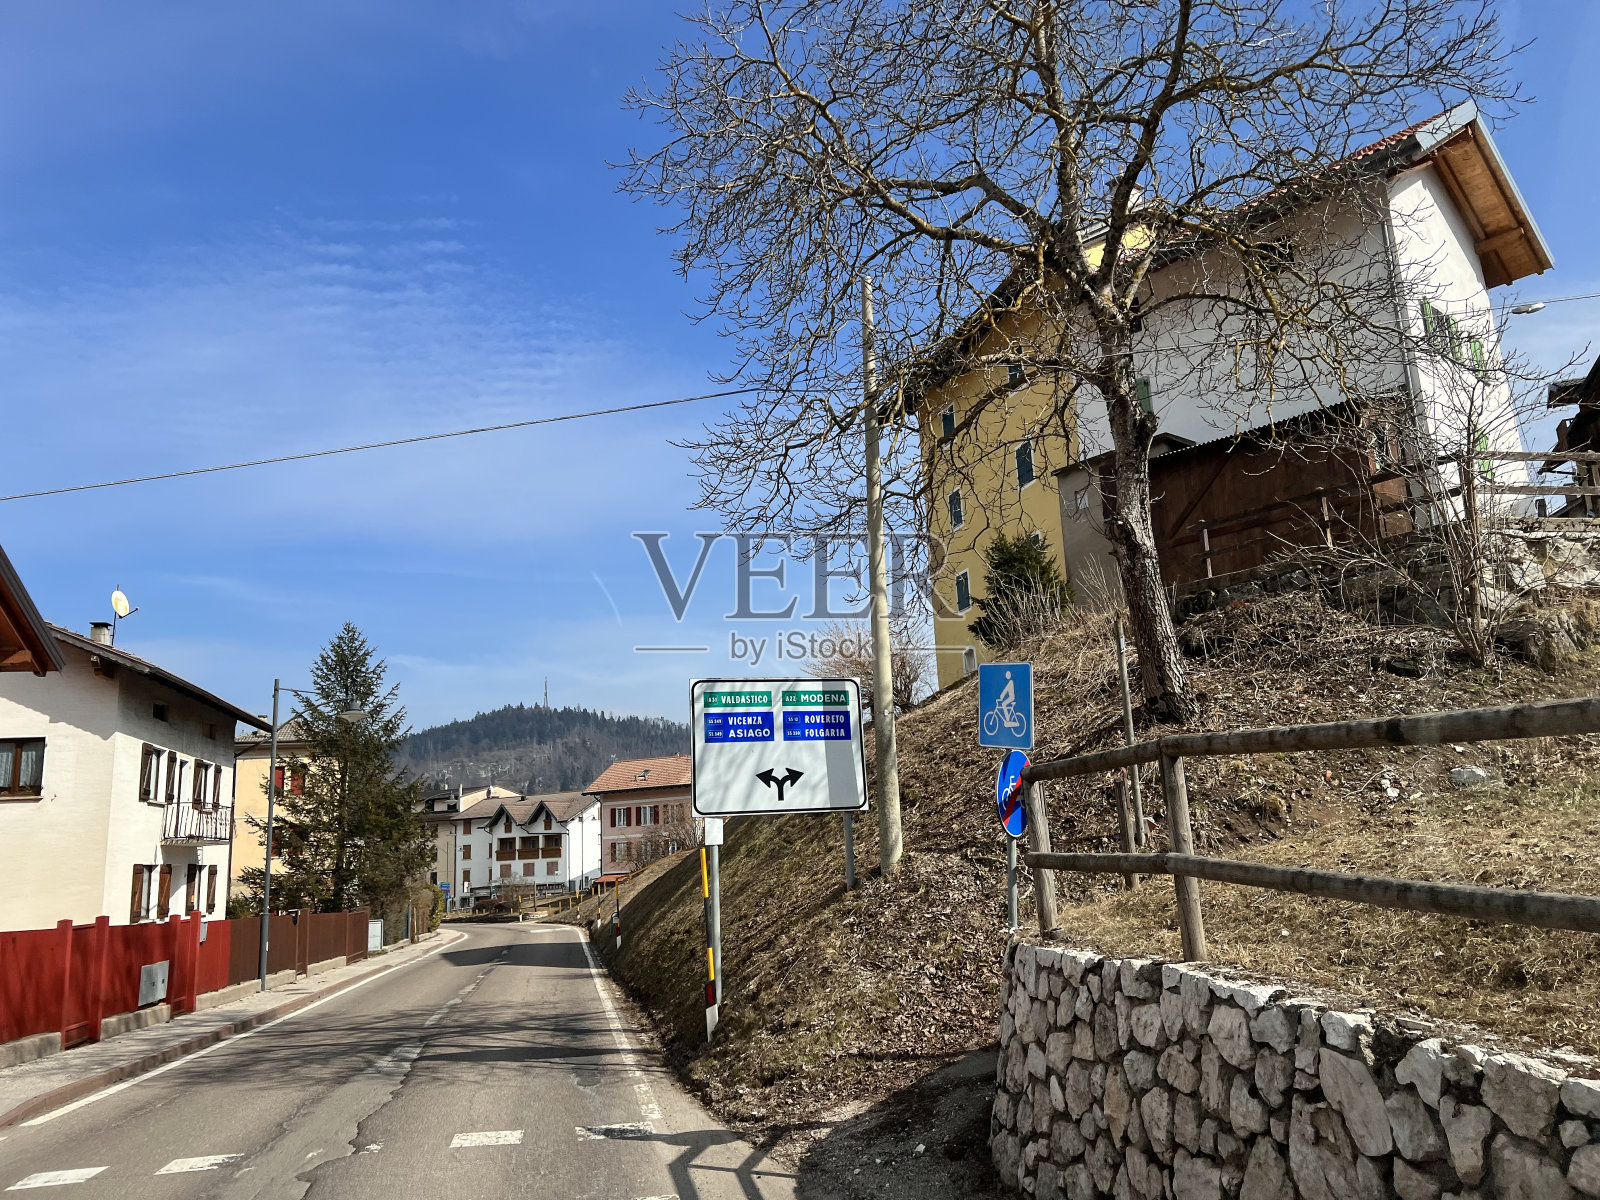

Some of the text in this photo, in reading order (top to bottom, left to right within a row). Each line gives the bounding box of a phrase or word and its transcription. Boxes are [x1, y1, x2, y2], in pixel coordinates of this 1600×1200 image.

[721, 695, 768, 704] VALDASTICO
[800, 694, 846, 702] MODENA
[728, 716, 762, 725] VICENZA
[804, 714, 845, 724] ROVERETO
[729, 728, 770, 738] ASIAGO
[805, 728, 845, 737] FOLGARIA
